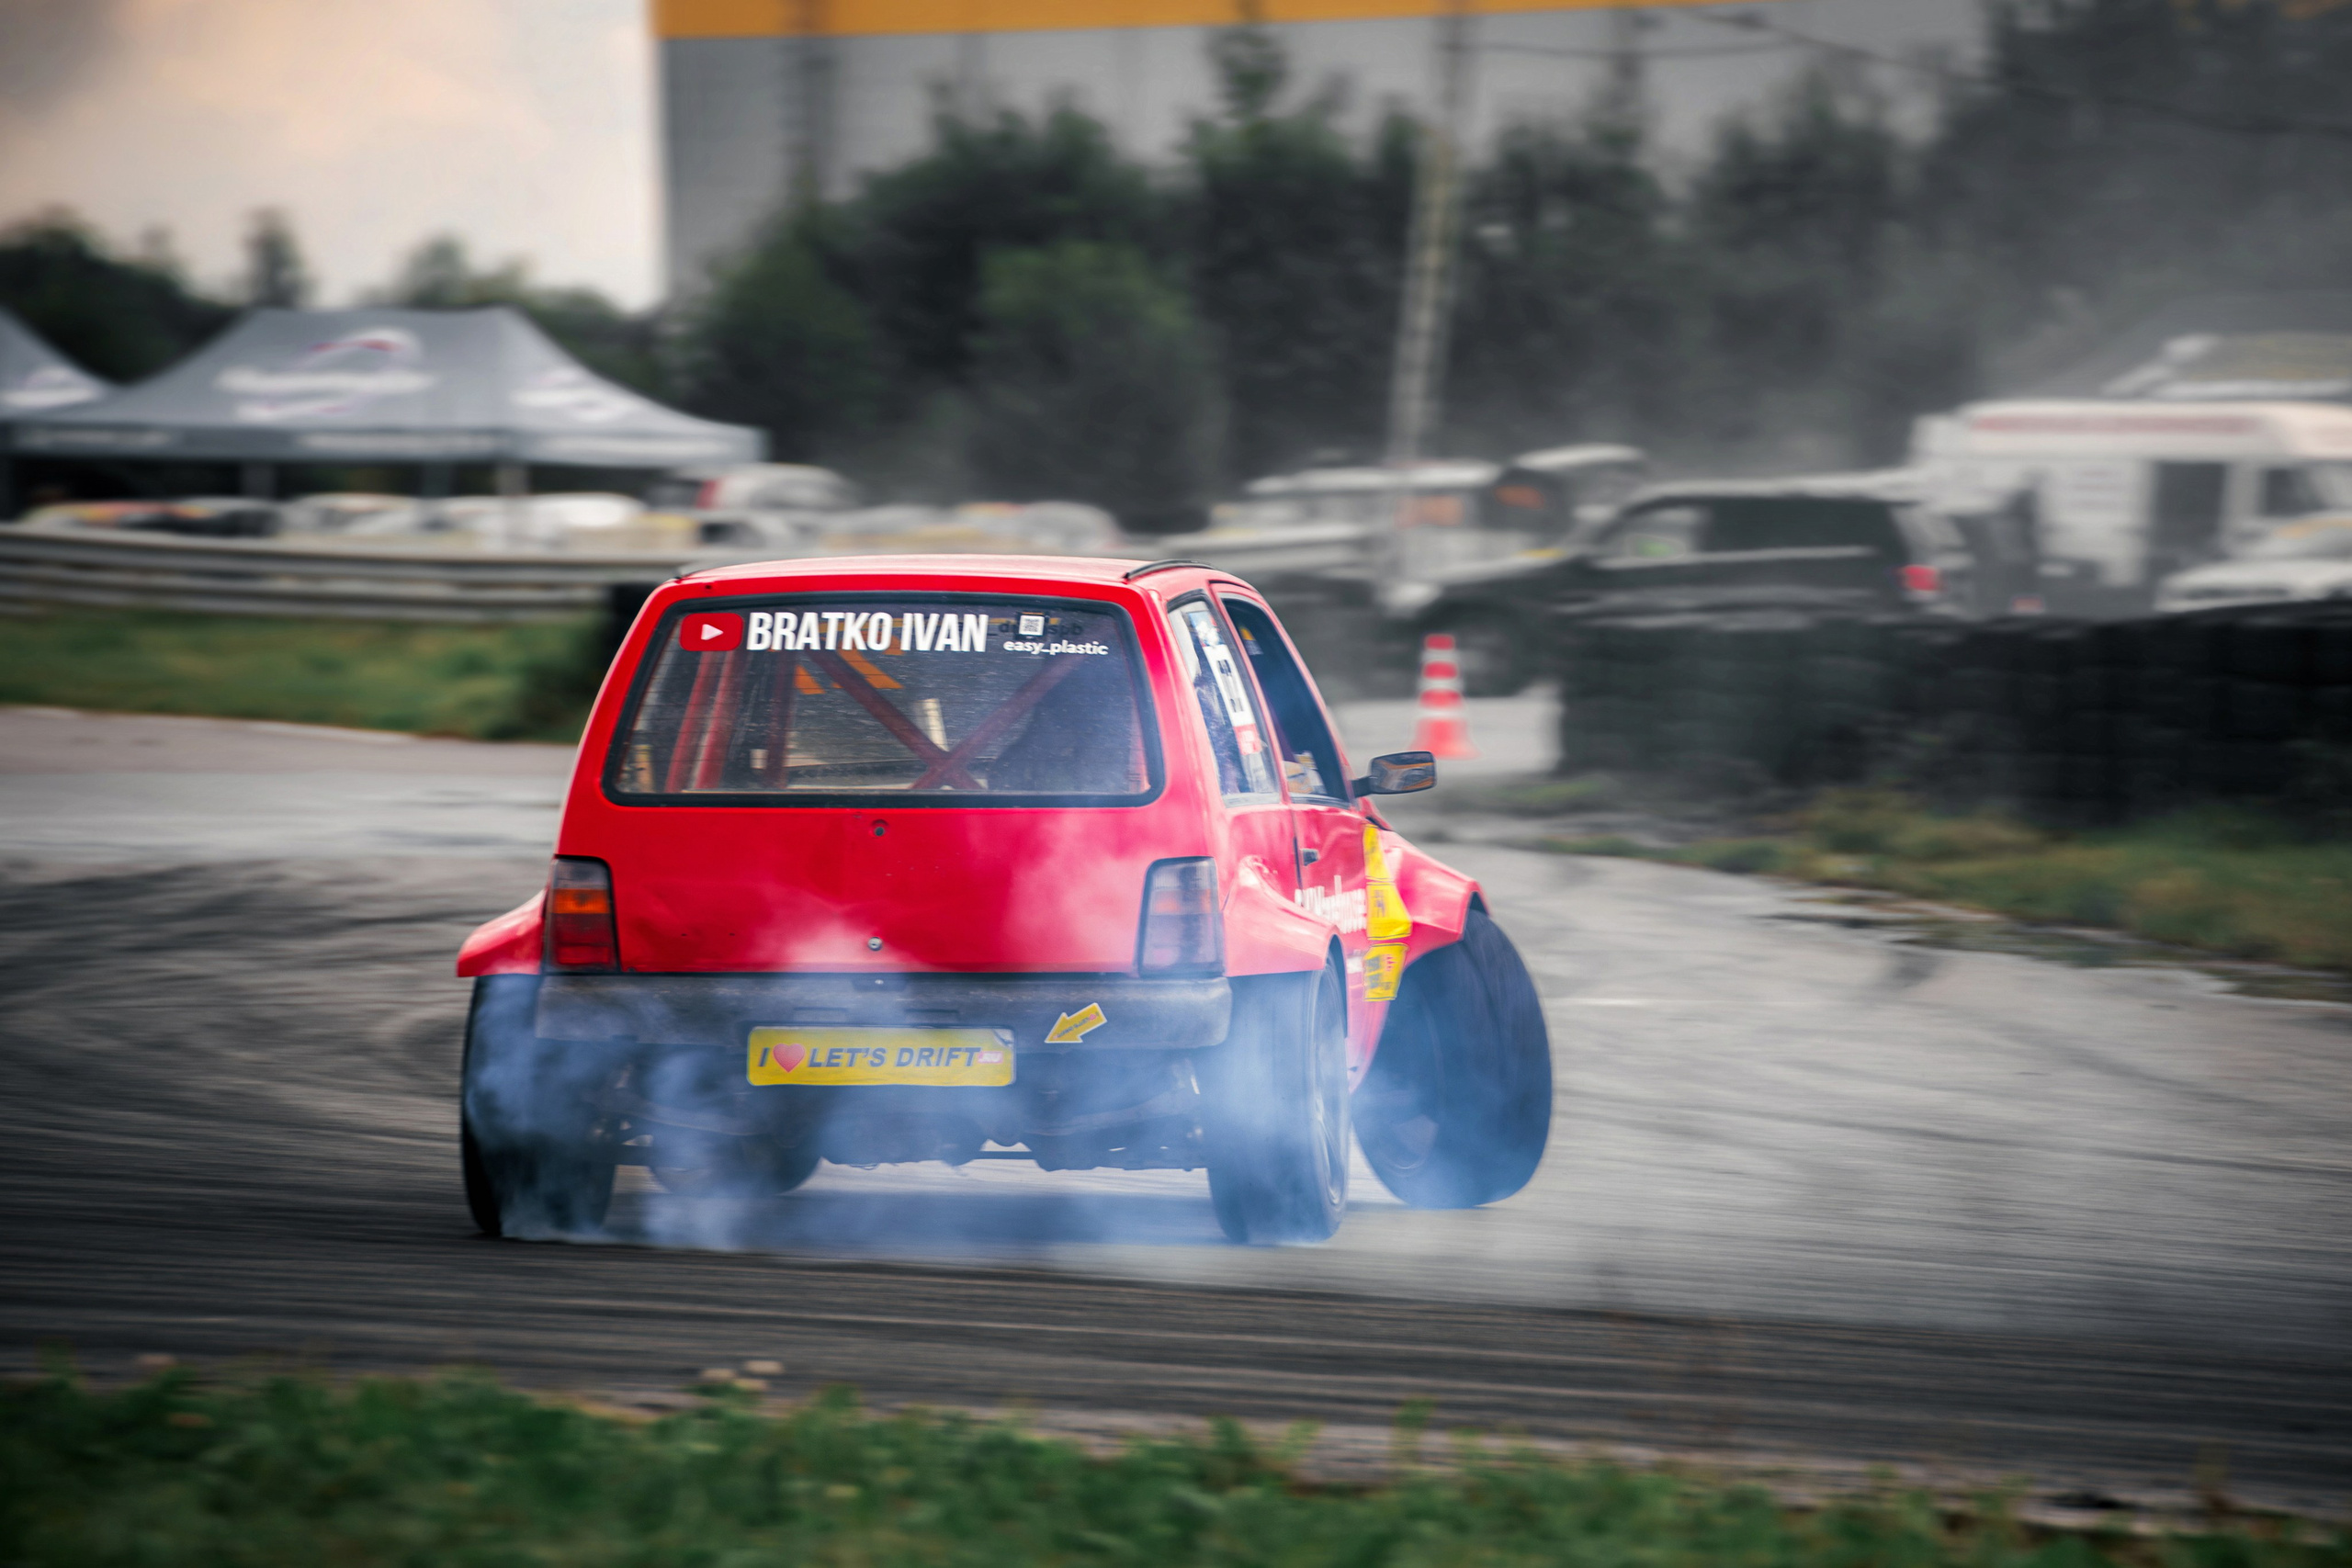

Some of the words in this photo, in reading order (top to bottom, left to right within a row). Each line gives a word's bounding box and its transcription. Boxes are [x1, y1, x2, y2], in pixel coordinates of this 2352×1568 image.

[746, 612, 893, 651] BRATKO
[900, 613, 989, 652] IVAN
[1002, 639, 1109, 656] easy_plastic
[757, 1047, 770, 1067] I
[808, 1047, 888, 1068] LET'S
